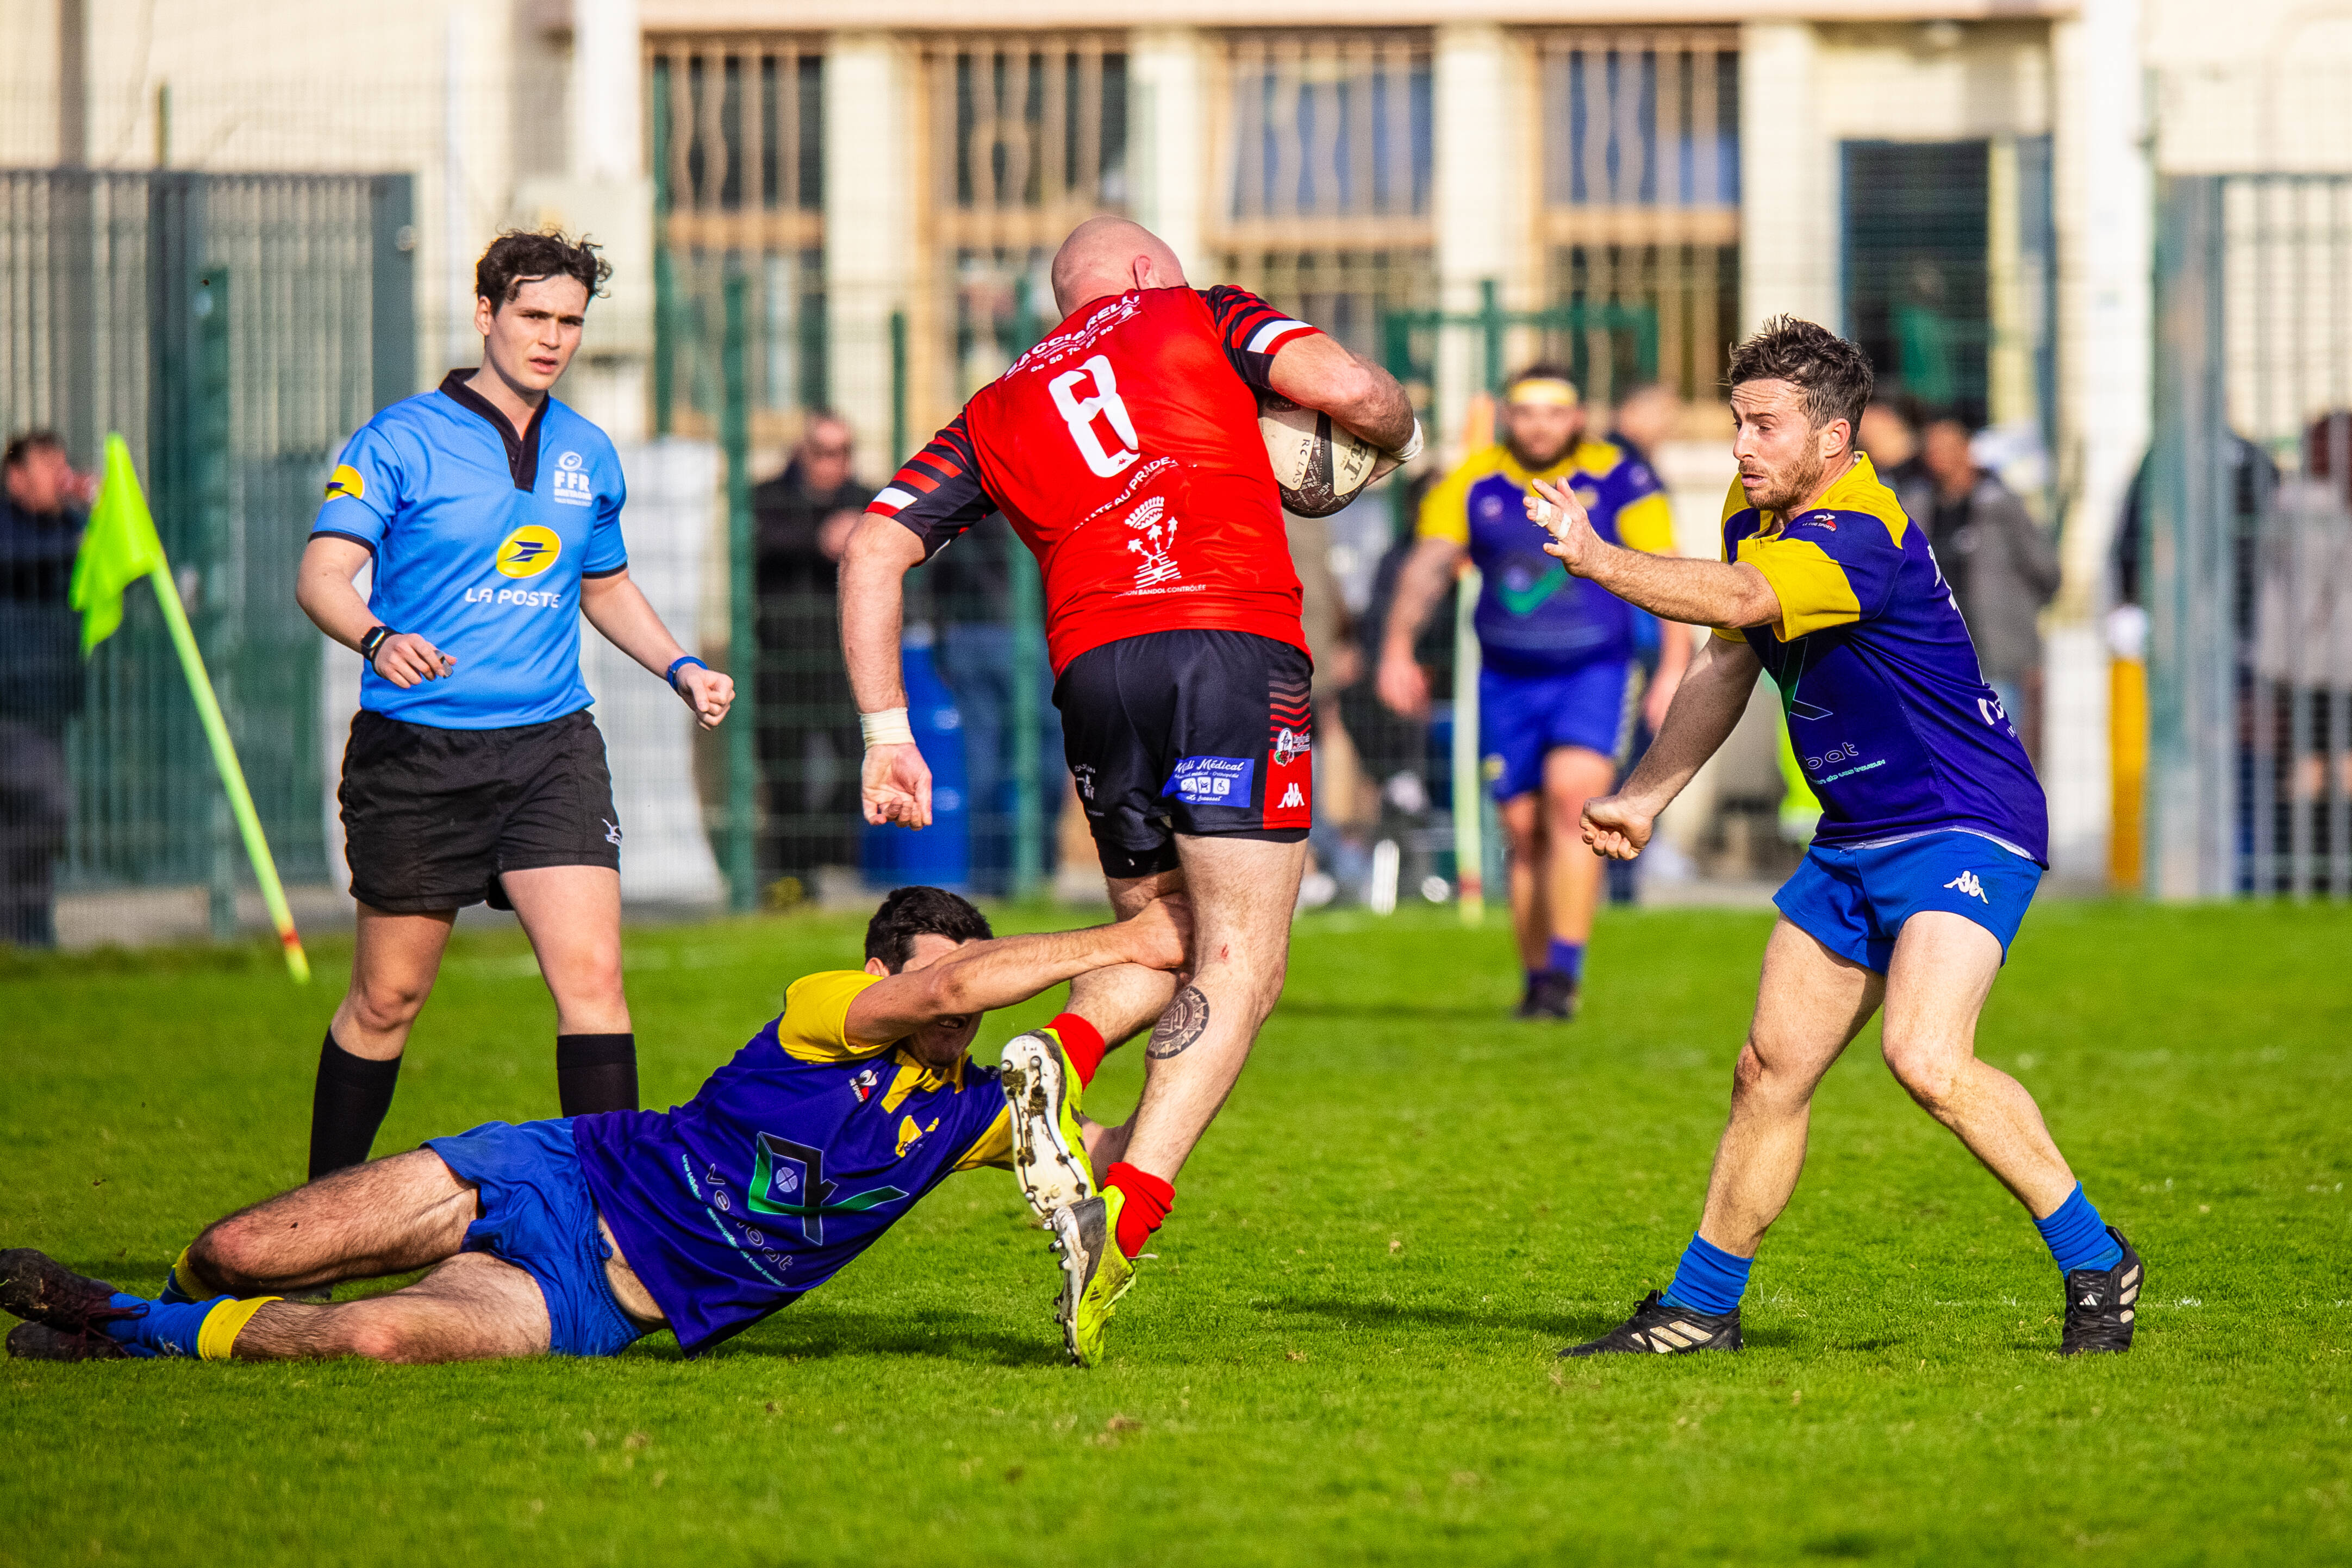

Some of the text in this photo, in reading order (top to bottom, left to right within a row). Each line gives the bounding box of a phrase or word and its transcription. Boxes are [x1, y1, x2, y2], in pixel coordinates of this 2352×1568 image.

[1048, 354, 1141, 478] 8
[554, 470, 590, 492] FFR
[465, 588, 562, 609] LA POSTE
[1196, 758, 1245, 771] Médical
